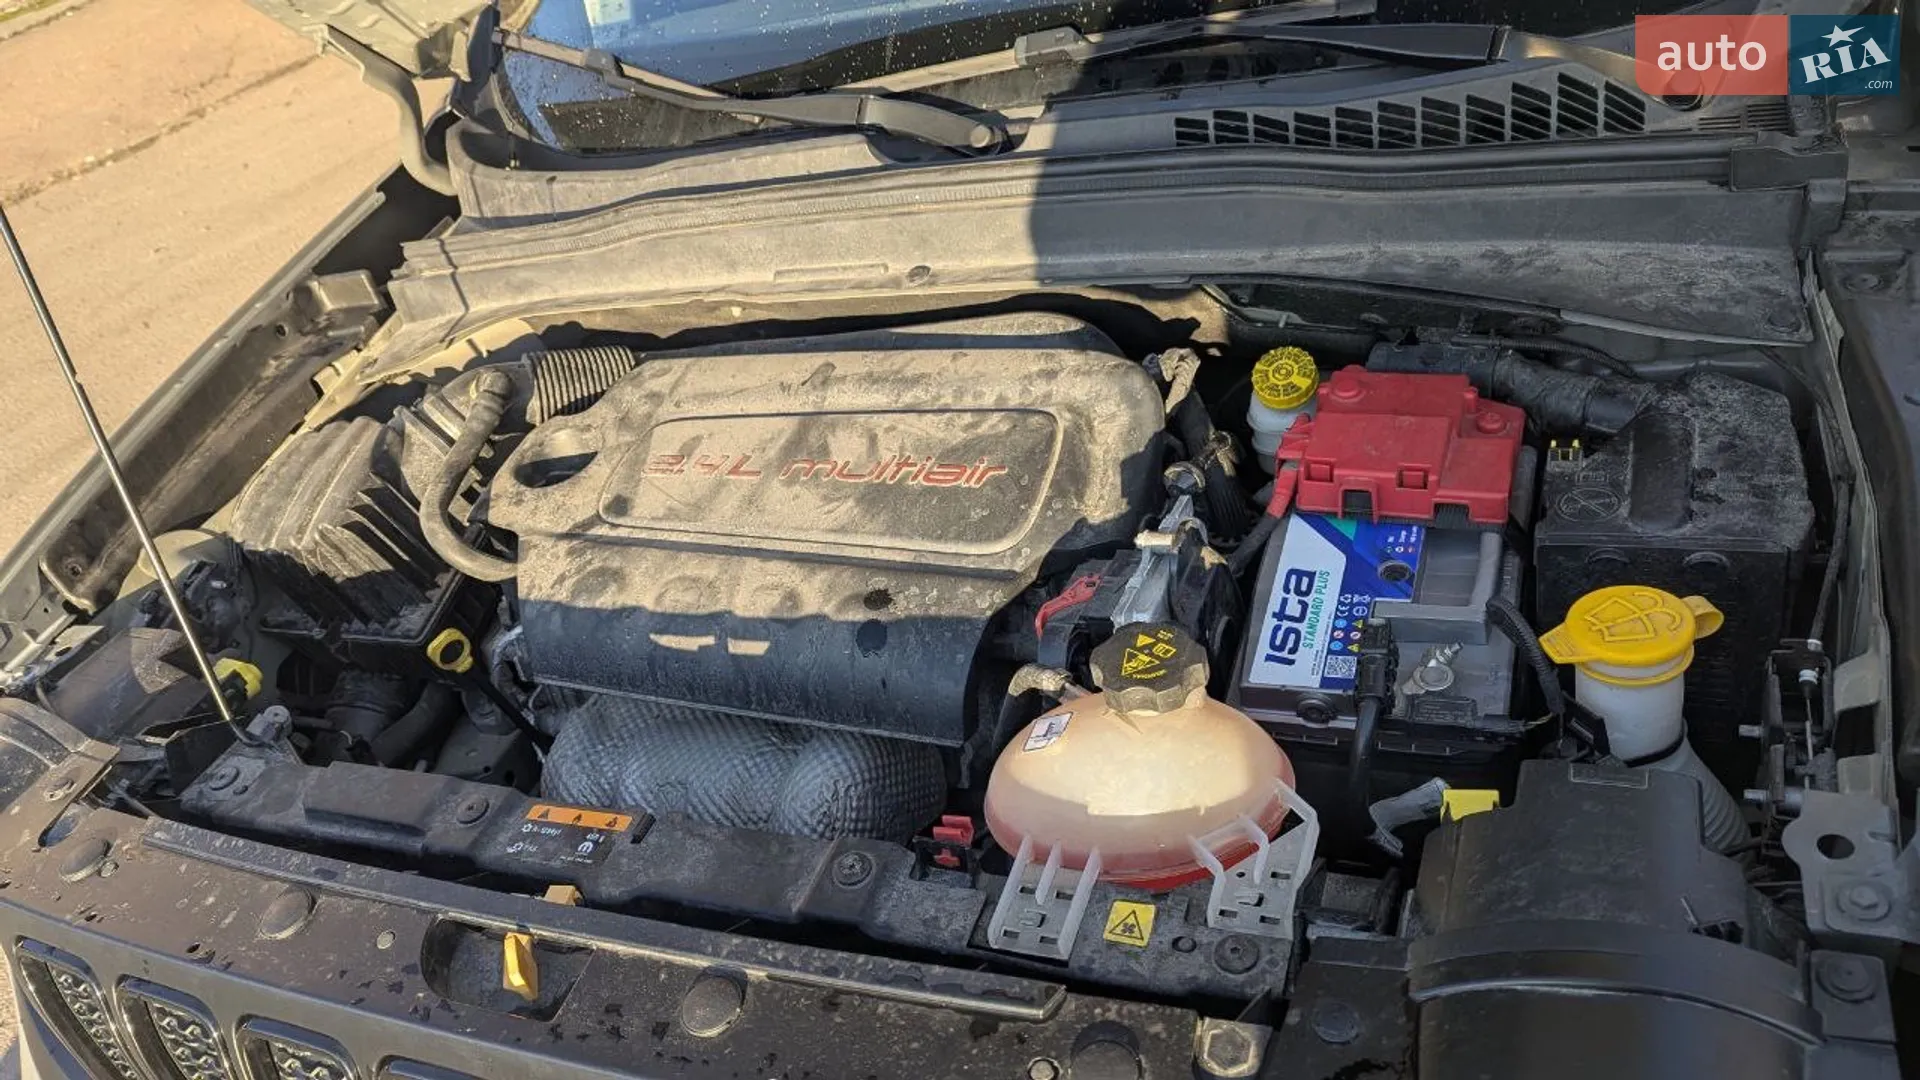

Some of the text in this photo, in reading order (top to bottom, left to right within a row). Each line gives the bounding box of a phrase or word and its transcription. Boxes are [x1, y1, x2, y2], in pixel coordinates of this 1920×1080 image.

[780, 453, 1008, 488] multiair
[1302, 595, 1324, 648] STANDARD
[1314, 569, 1330, 595] PLUS
